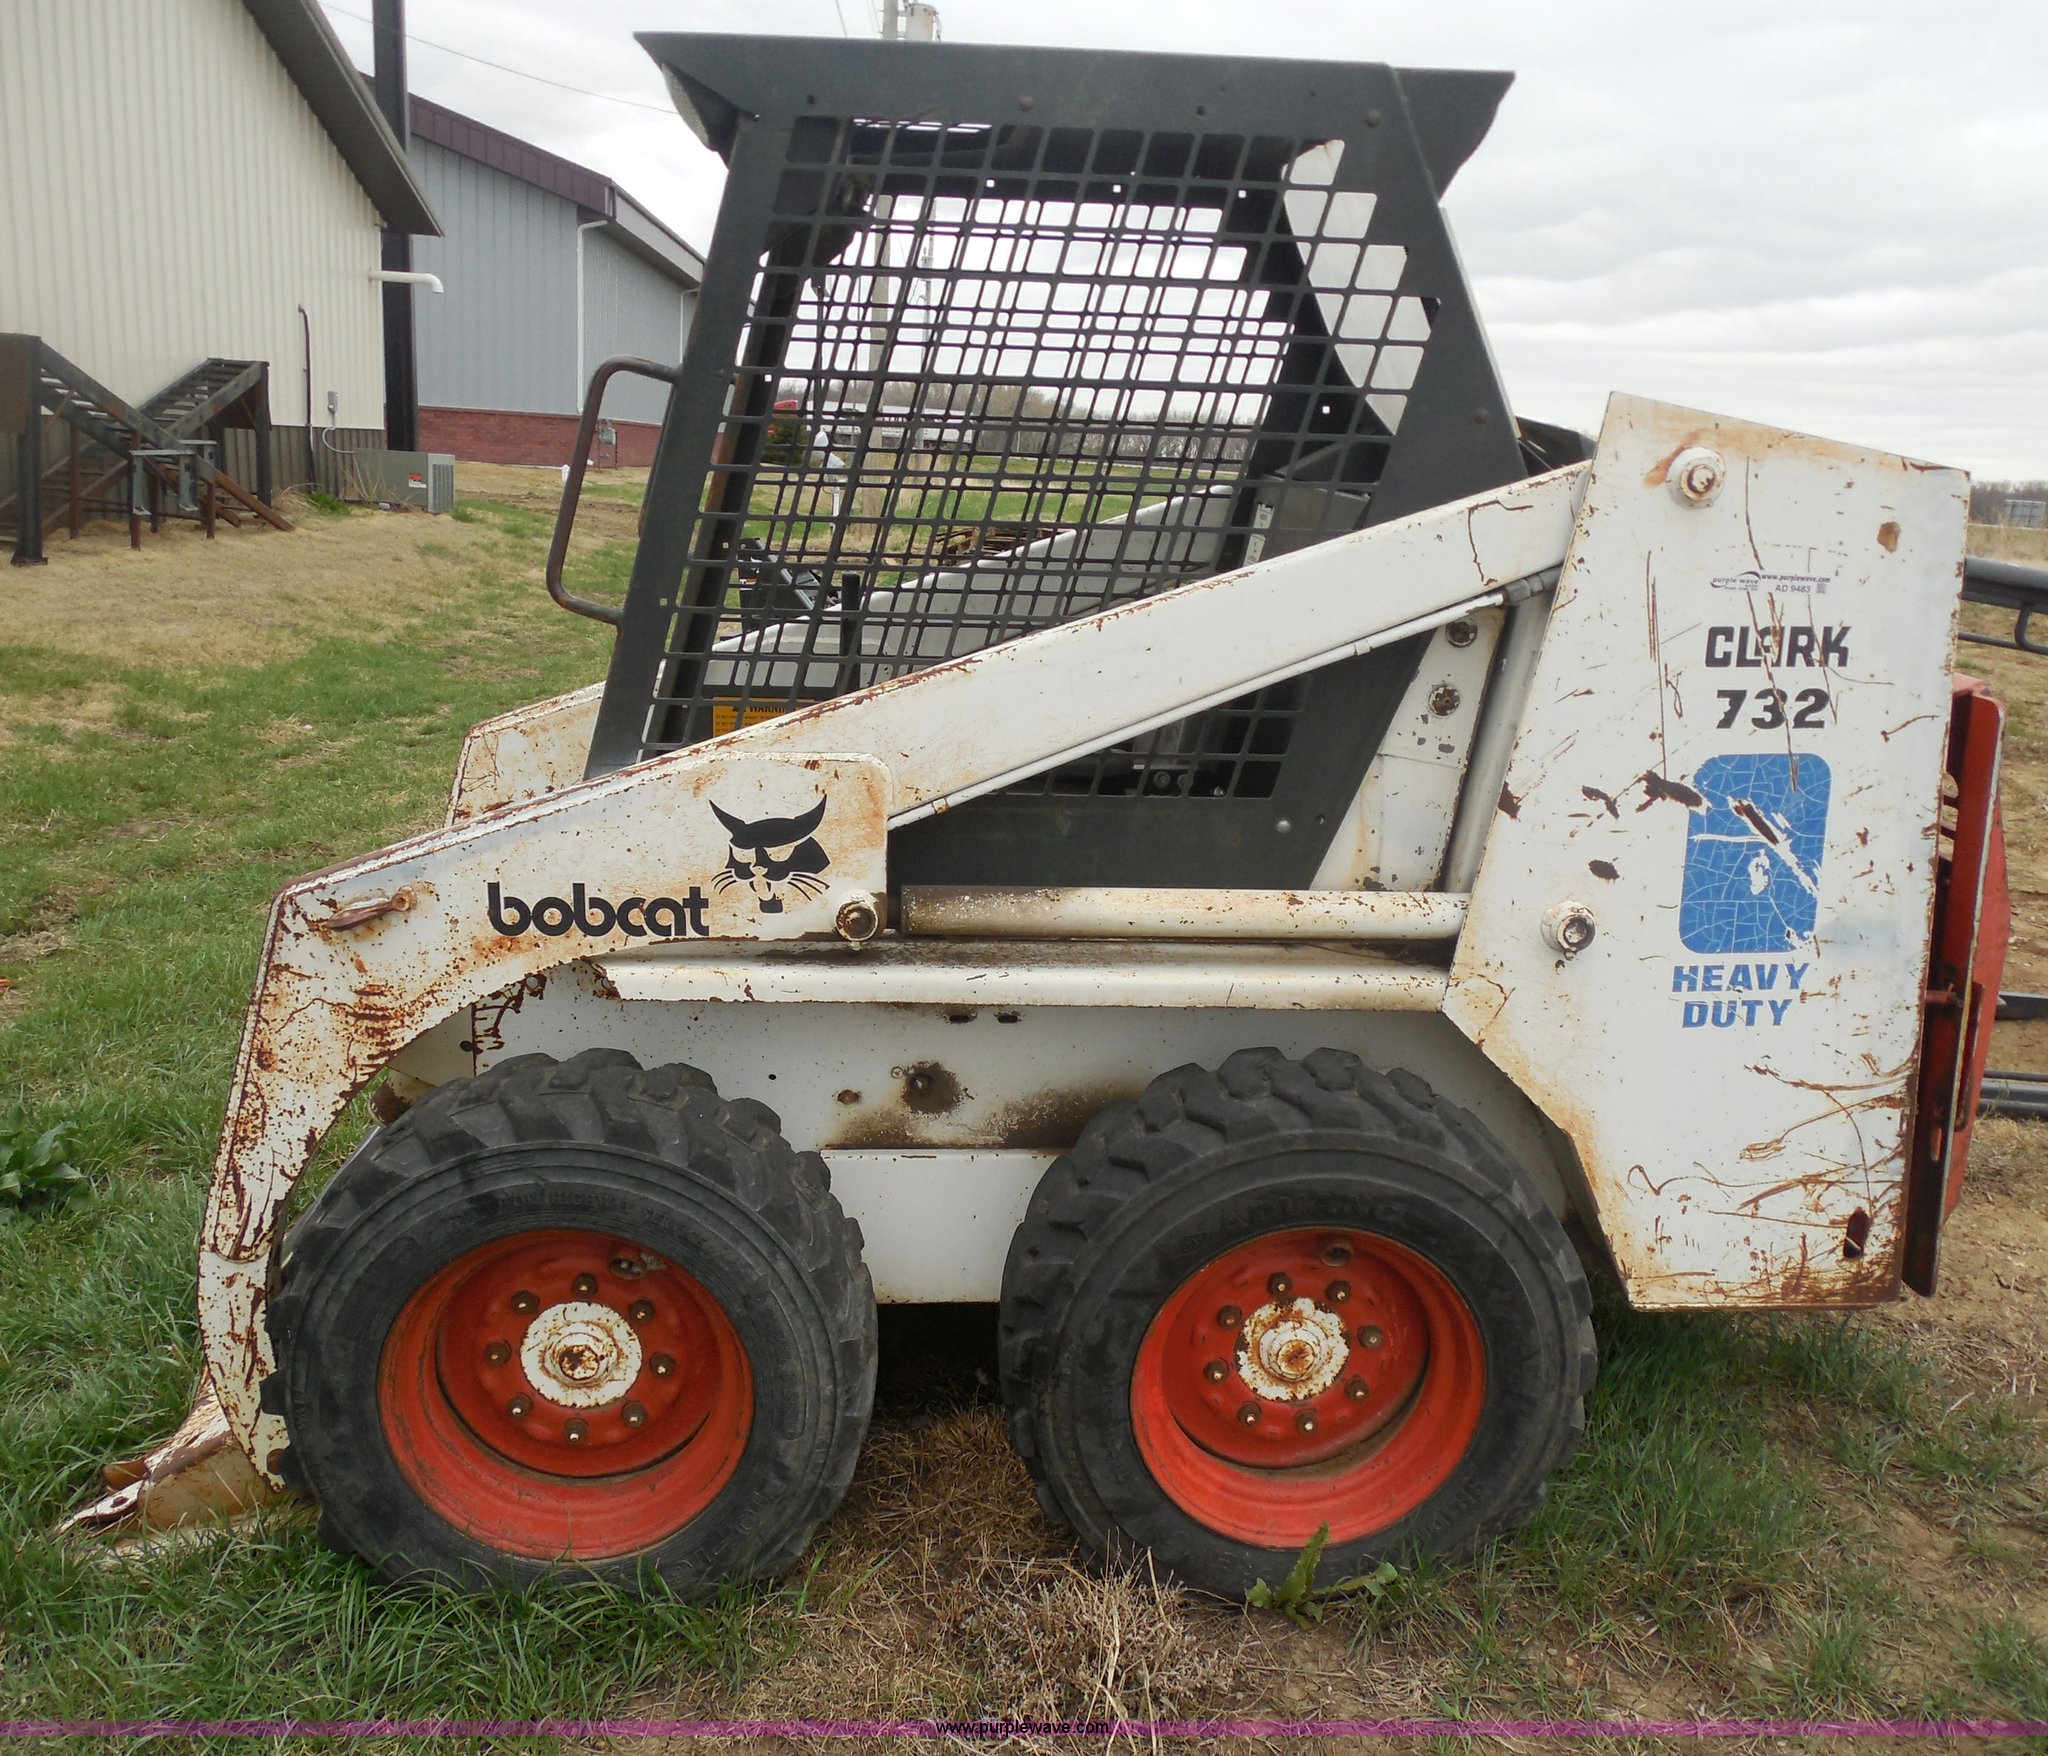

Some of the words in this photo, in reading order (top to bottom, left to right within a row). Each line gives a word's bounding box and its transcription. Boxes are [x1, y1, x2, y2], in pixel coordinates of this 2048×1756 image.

[1712, 577, 1737, 585] purple
[1761, 573, 1831, 582] www.purplewave.com
[1775, 584, 1788, 592] AD
[1705, 626, 1851, 667] CLARK
[1716, 688, 1829, 729] 732
[487, 882, 710, 936] bobcat
[1672, 963, 1810, 993] HEAVY
[1682, 999, 1793, 1029] DUTY
